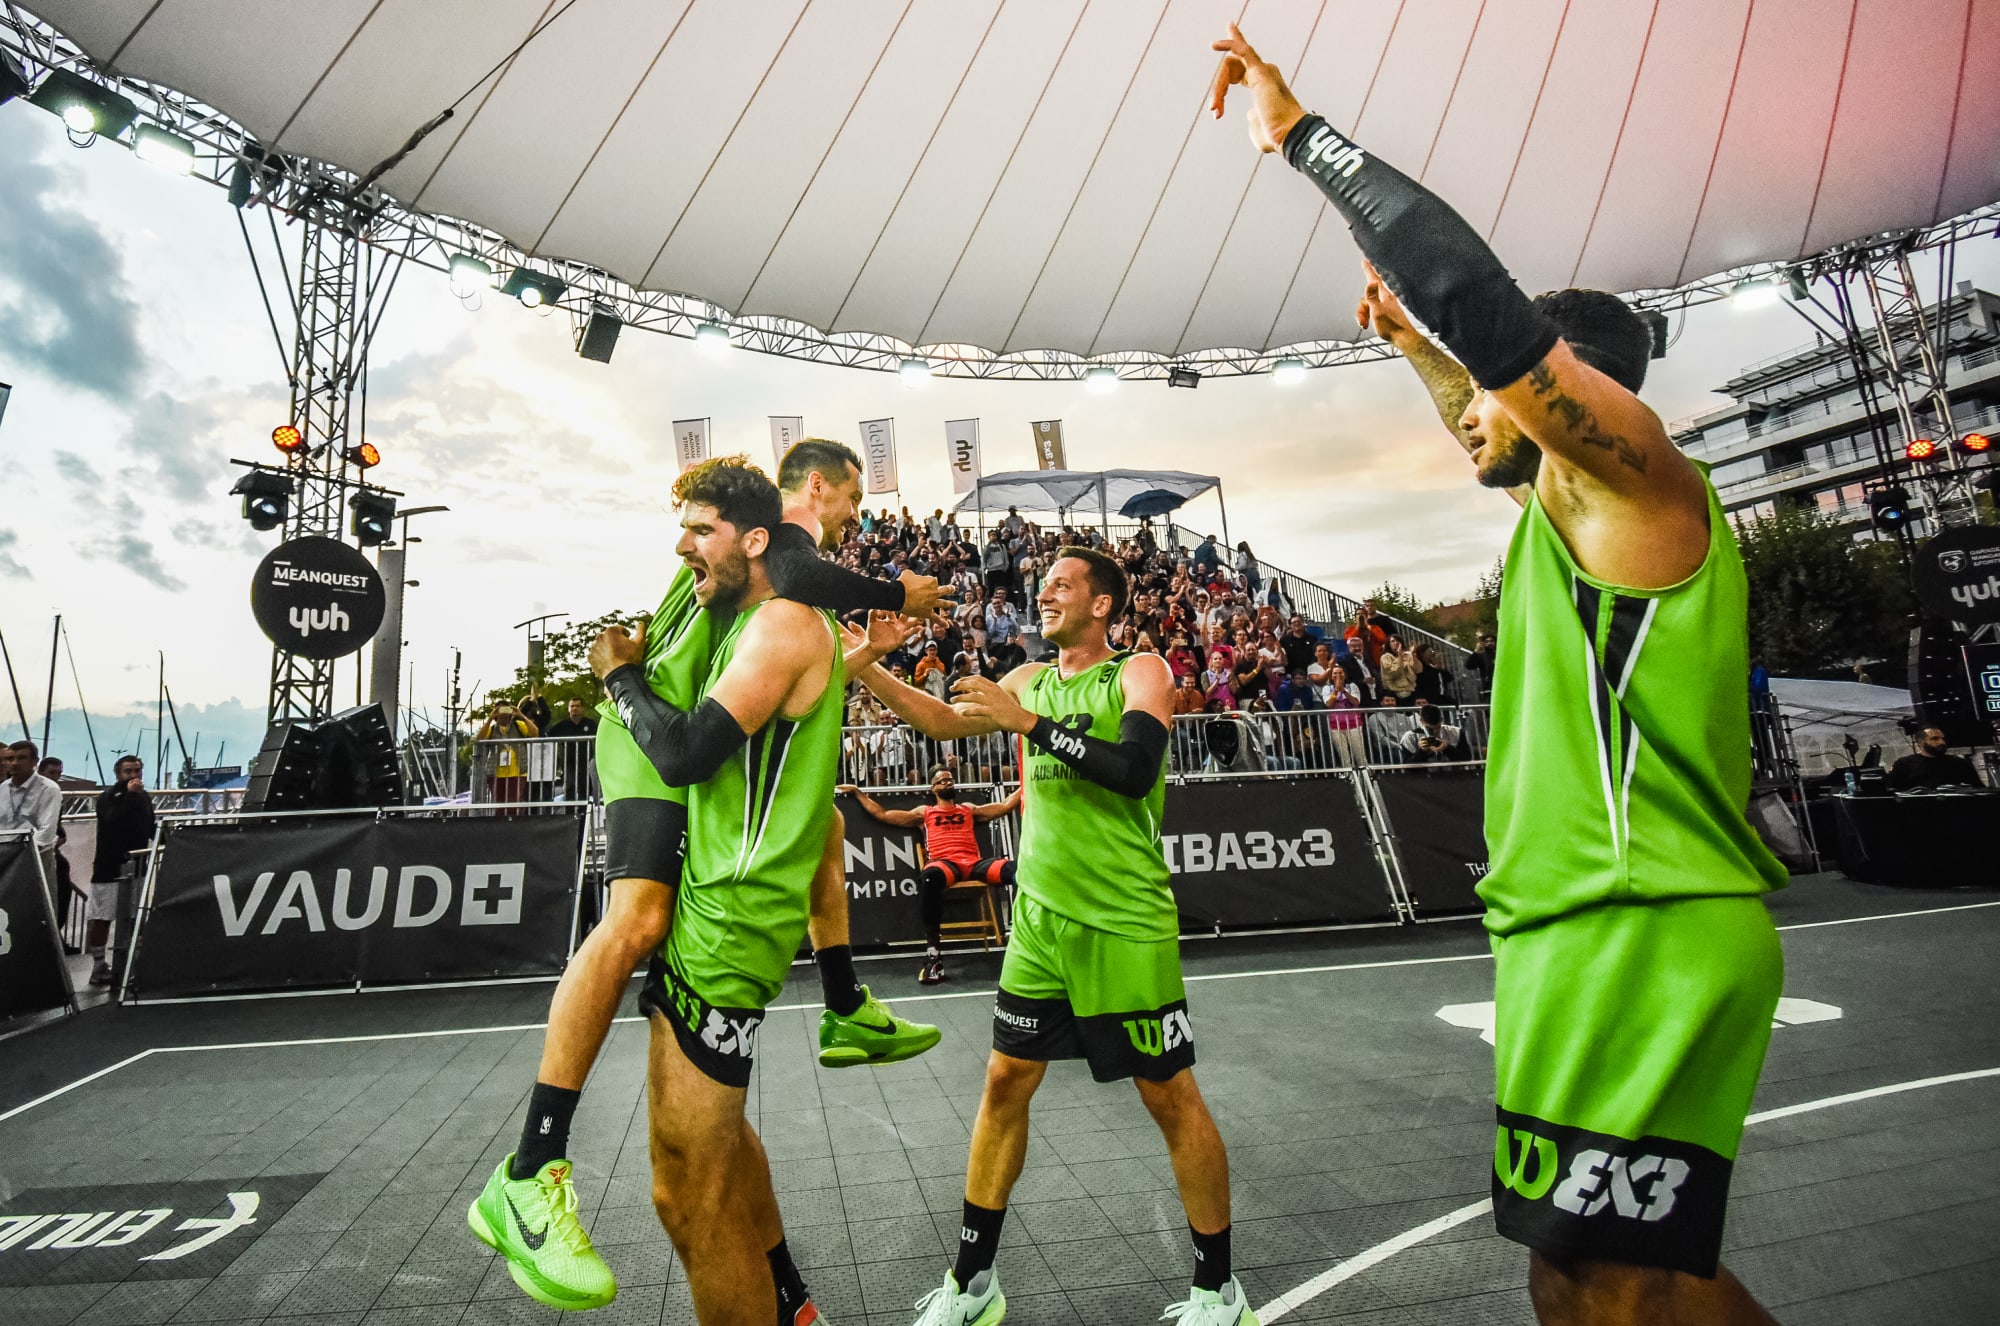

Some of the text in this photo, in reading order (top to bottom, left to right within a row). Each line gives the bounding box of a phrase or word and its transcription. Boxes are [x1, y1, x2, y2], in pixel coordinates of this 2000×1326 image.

[1307, 125, 1365, 178] yuh
[867, 422, 887, 490] deRham
[273, 566, 369, 588] MEANQUEST
[289, 602, 350, 638] yuh
[213, 864, 452, 937] VAUD
